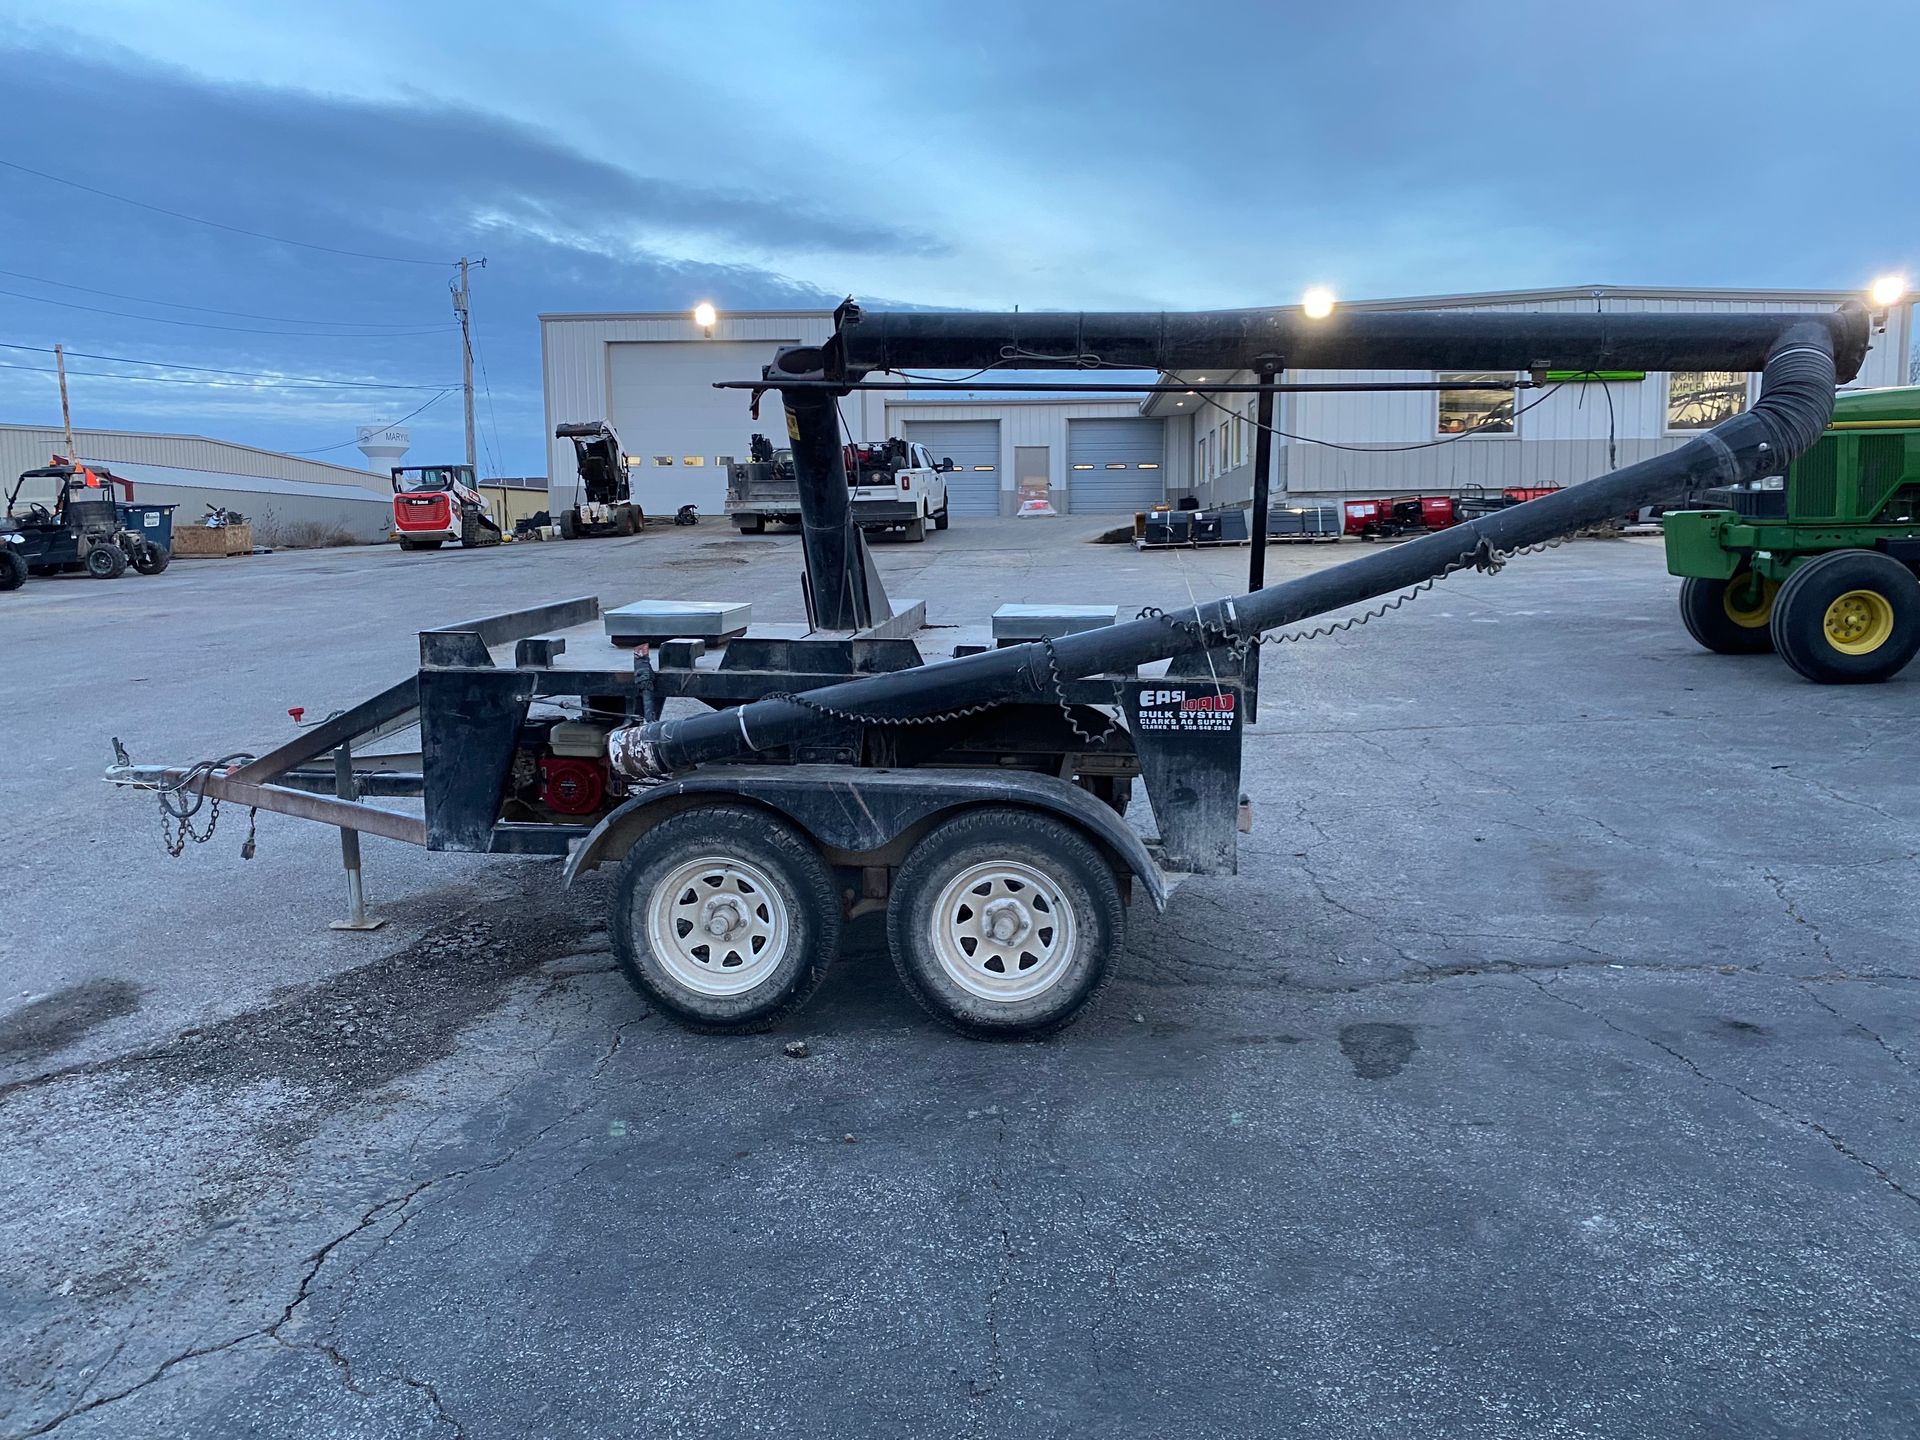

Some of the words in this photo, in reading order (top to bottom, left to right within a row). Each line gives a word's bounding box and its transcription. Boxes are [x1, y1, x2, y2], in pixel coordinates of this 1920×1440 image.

[1139, 690, 1186, 707] EASI
[1181, 694, 1234, 711] LOAD
[1179, 711, 1235, 719] SYSTEM
